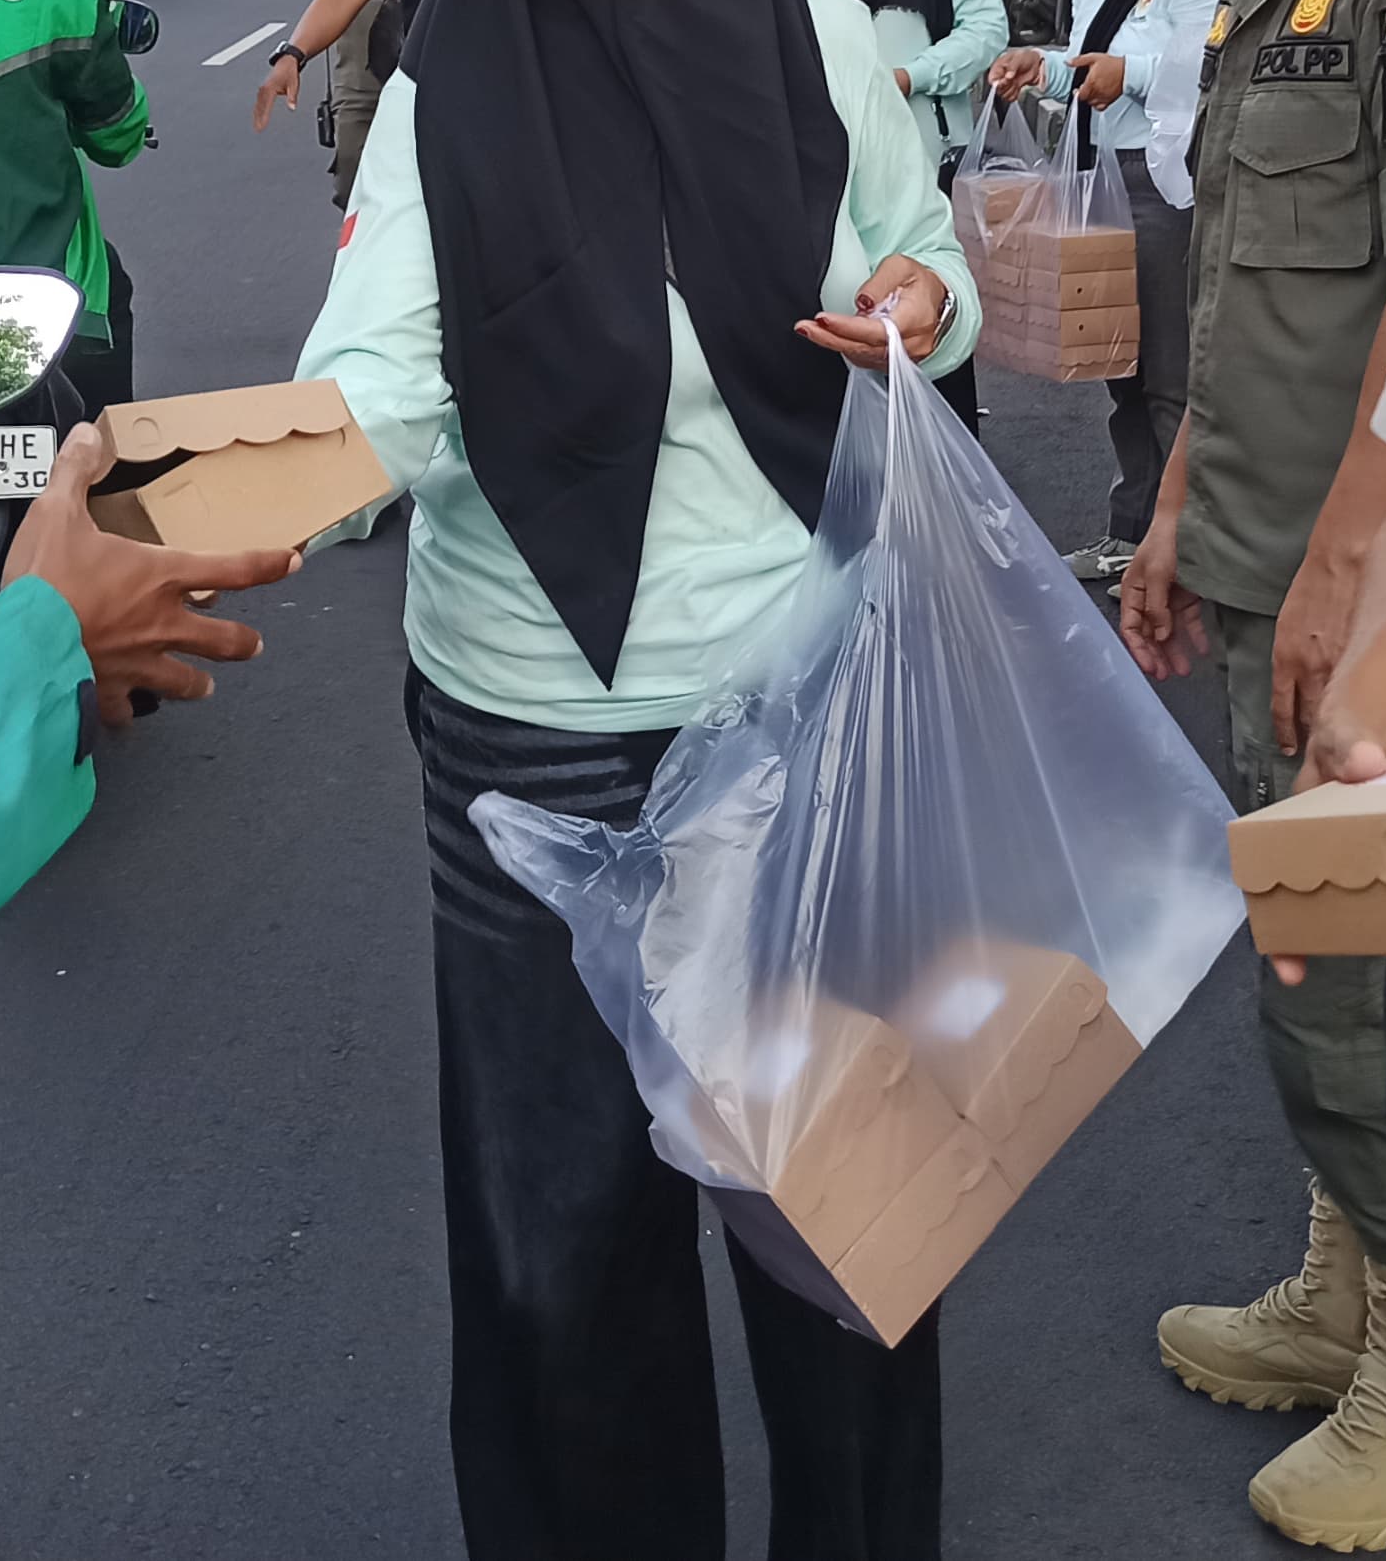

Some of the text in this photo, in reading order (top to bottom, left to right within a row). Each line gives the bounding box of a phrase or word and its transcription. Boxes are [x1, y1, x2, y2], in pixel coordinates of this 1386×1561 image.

[1258, 46, 1343, 75] POL PP
[0, 434, 38, 460] HE
